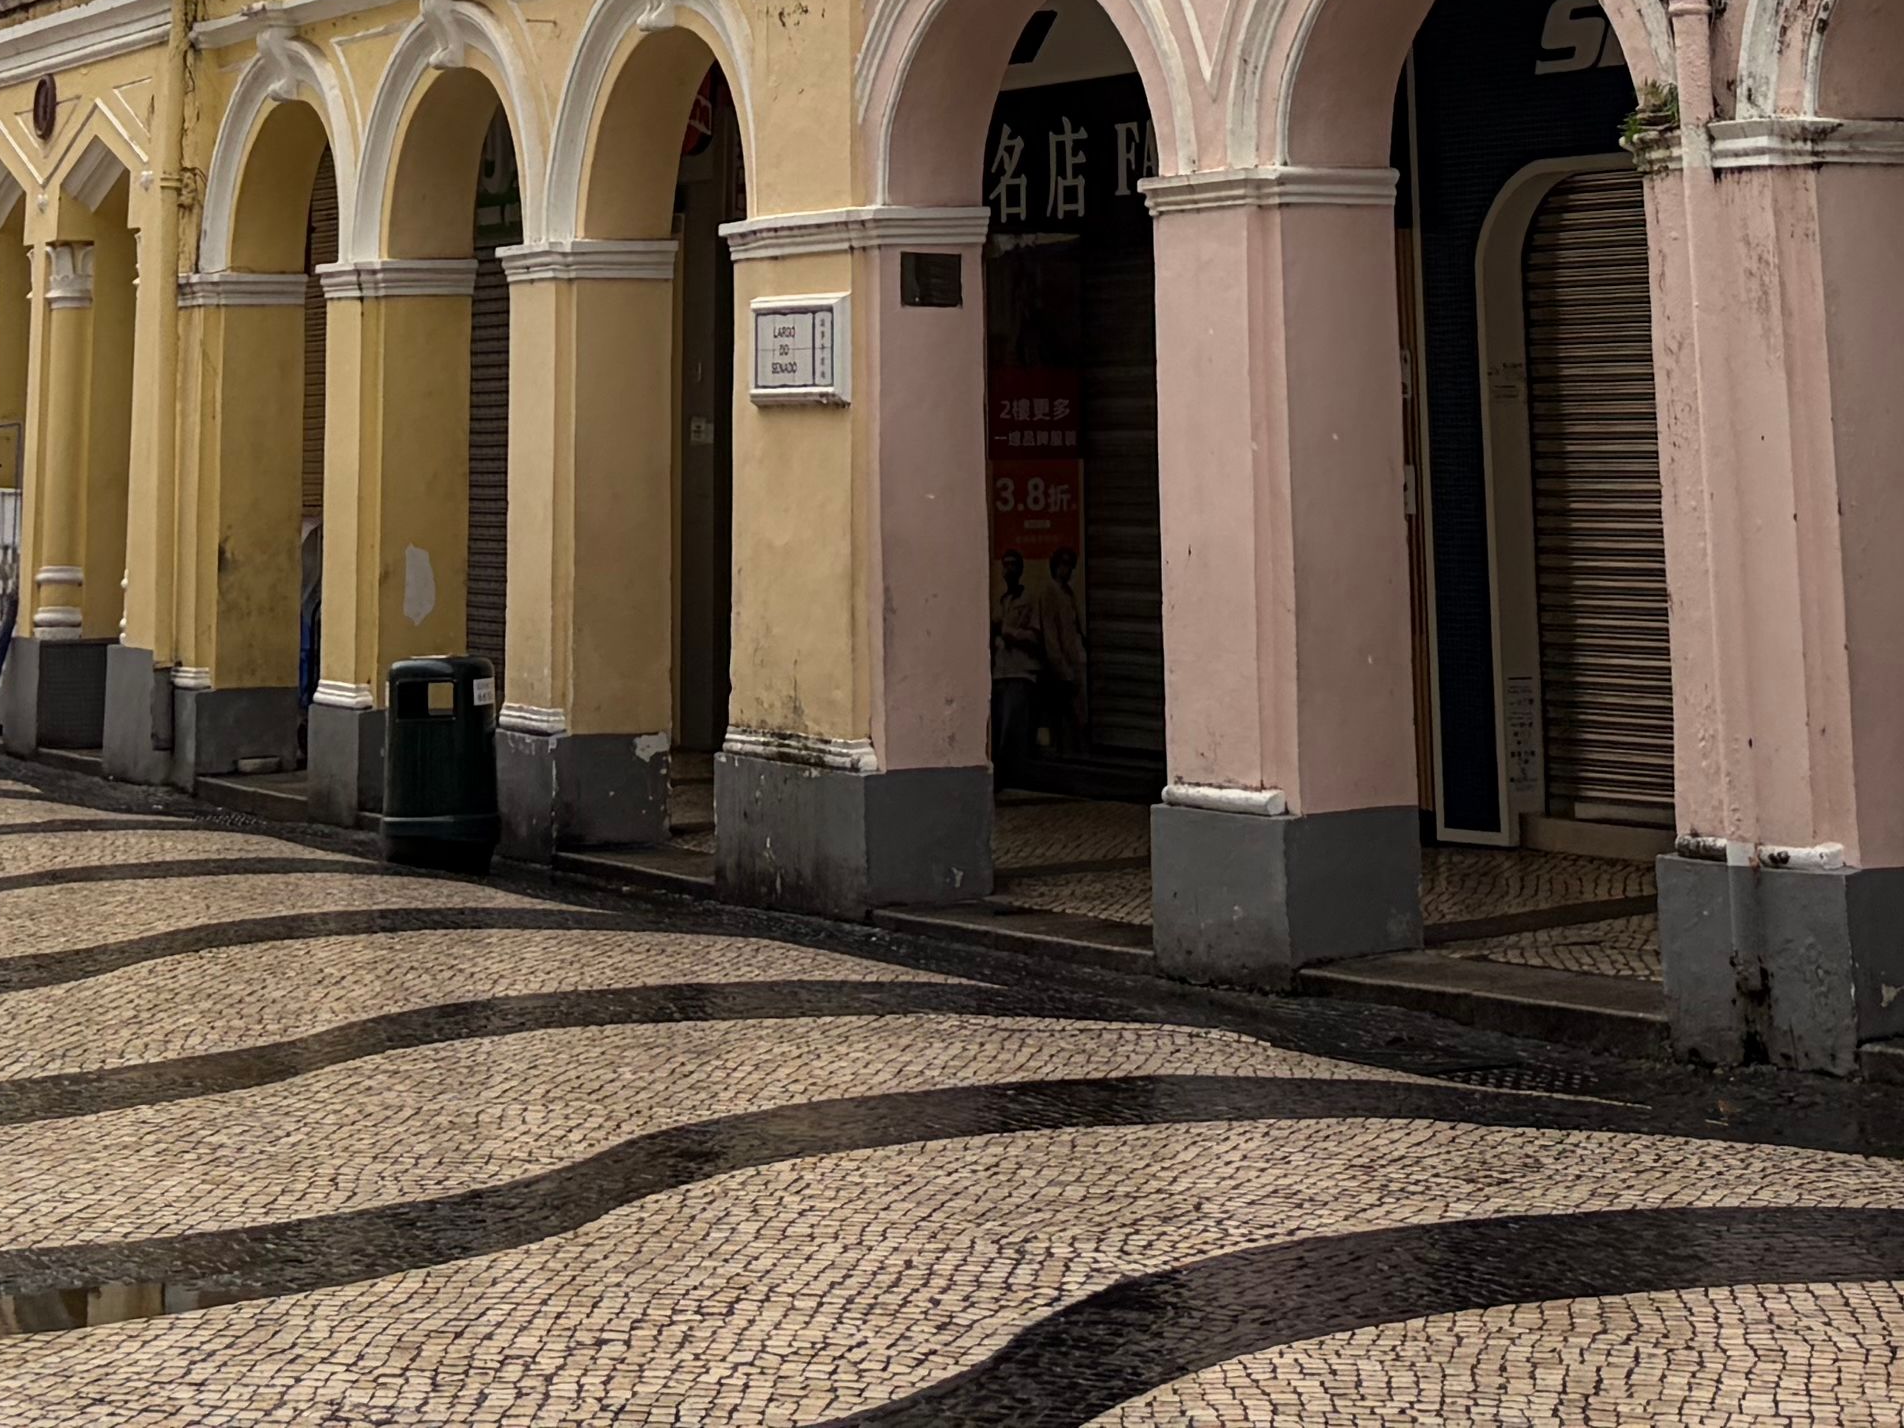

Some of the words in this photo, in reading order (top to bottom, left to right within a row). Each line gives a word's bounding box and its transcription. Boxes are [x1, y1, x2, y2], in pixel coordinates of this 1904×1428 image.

[988, 115, 1088, 224] 名店
[772, 325, 796, 339] LARGO
[778, 343, 790, 356] DO
[771, 361, 798, 375] SENADO
[999, 397, 1072, 422] 2樓更多
[995, 476, 1071, 514] 3.8折
